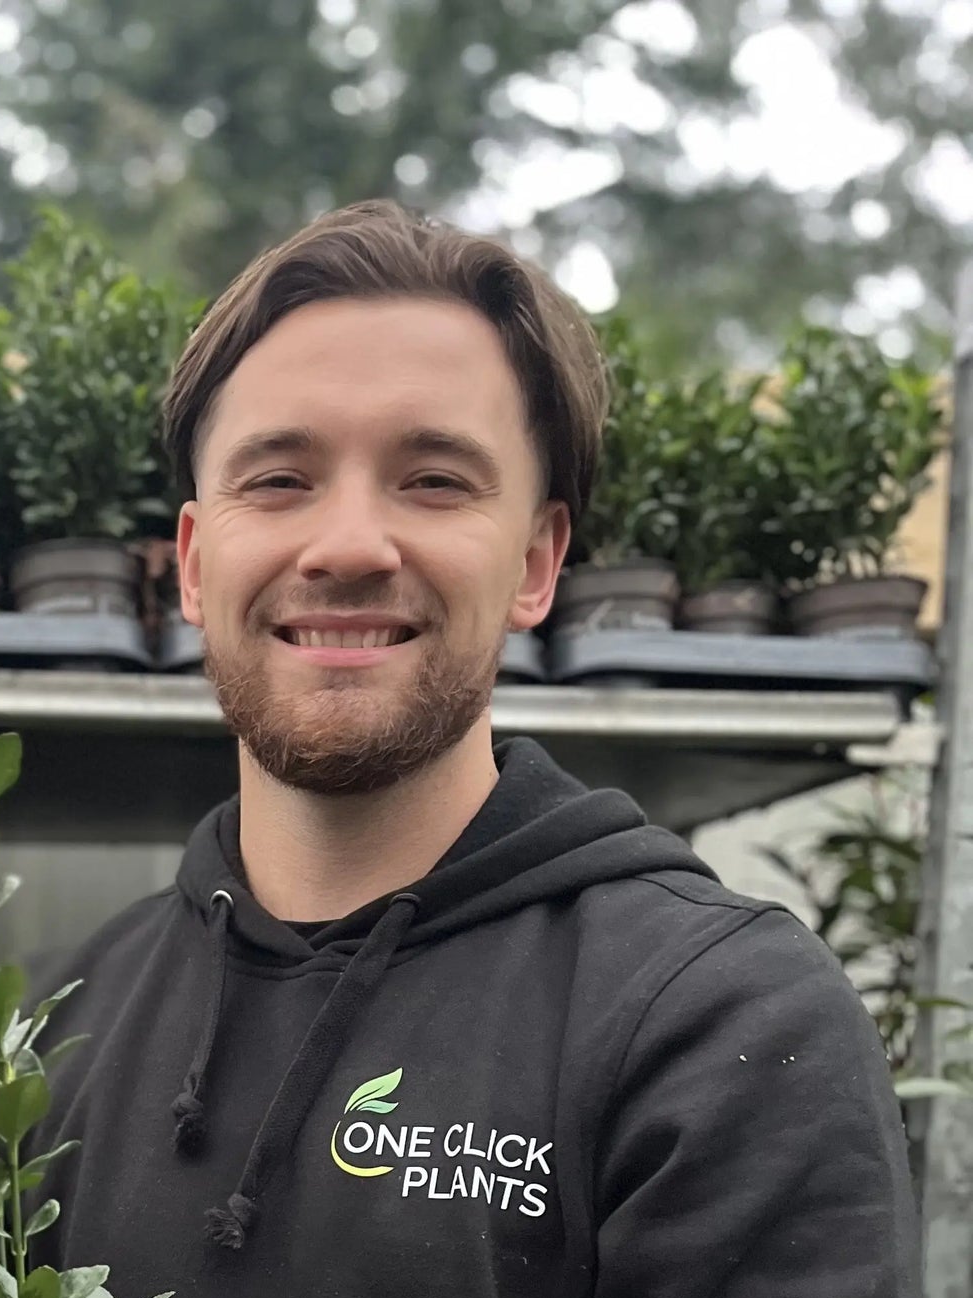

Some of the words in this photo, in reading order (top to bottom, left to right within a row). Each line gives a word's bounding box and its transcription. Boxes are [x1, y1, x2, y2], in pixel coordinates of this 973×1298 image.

[343, 1121, 435, 1158] ONE
[443, 1122, 553, 1175] CLICK
[401, 1166, 548, 1218] PLANTS
